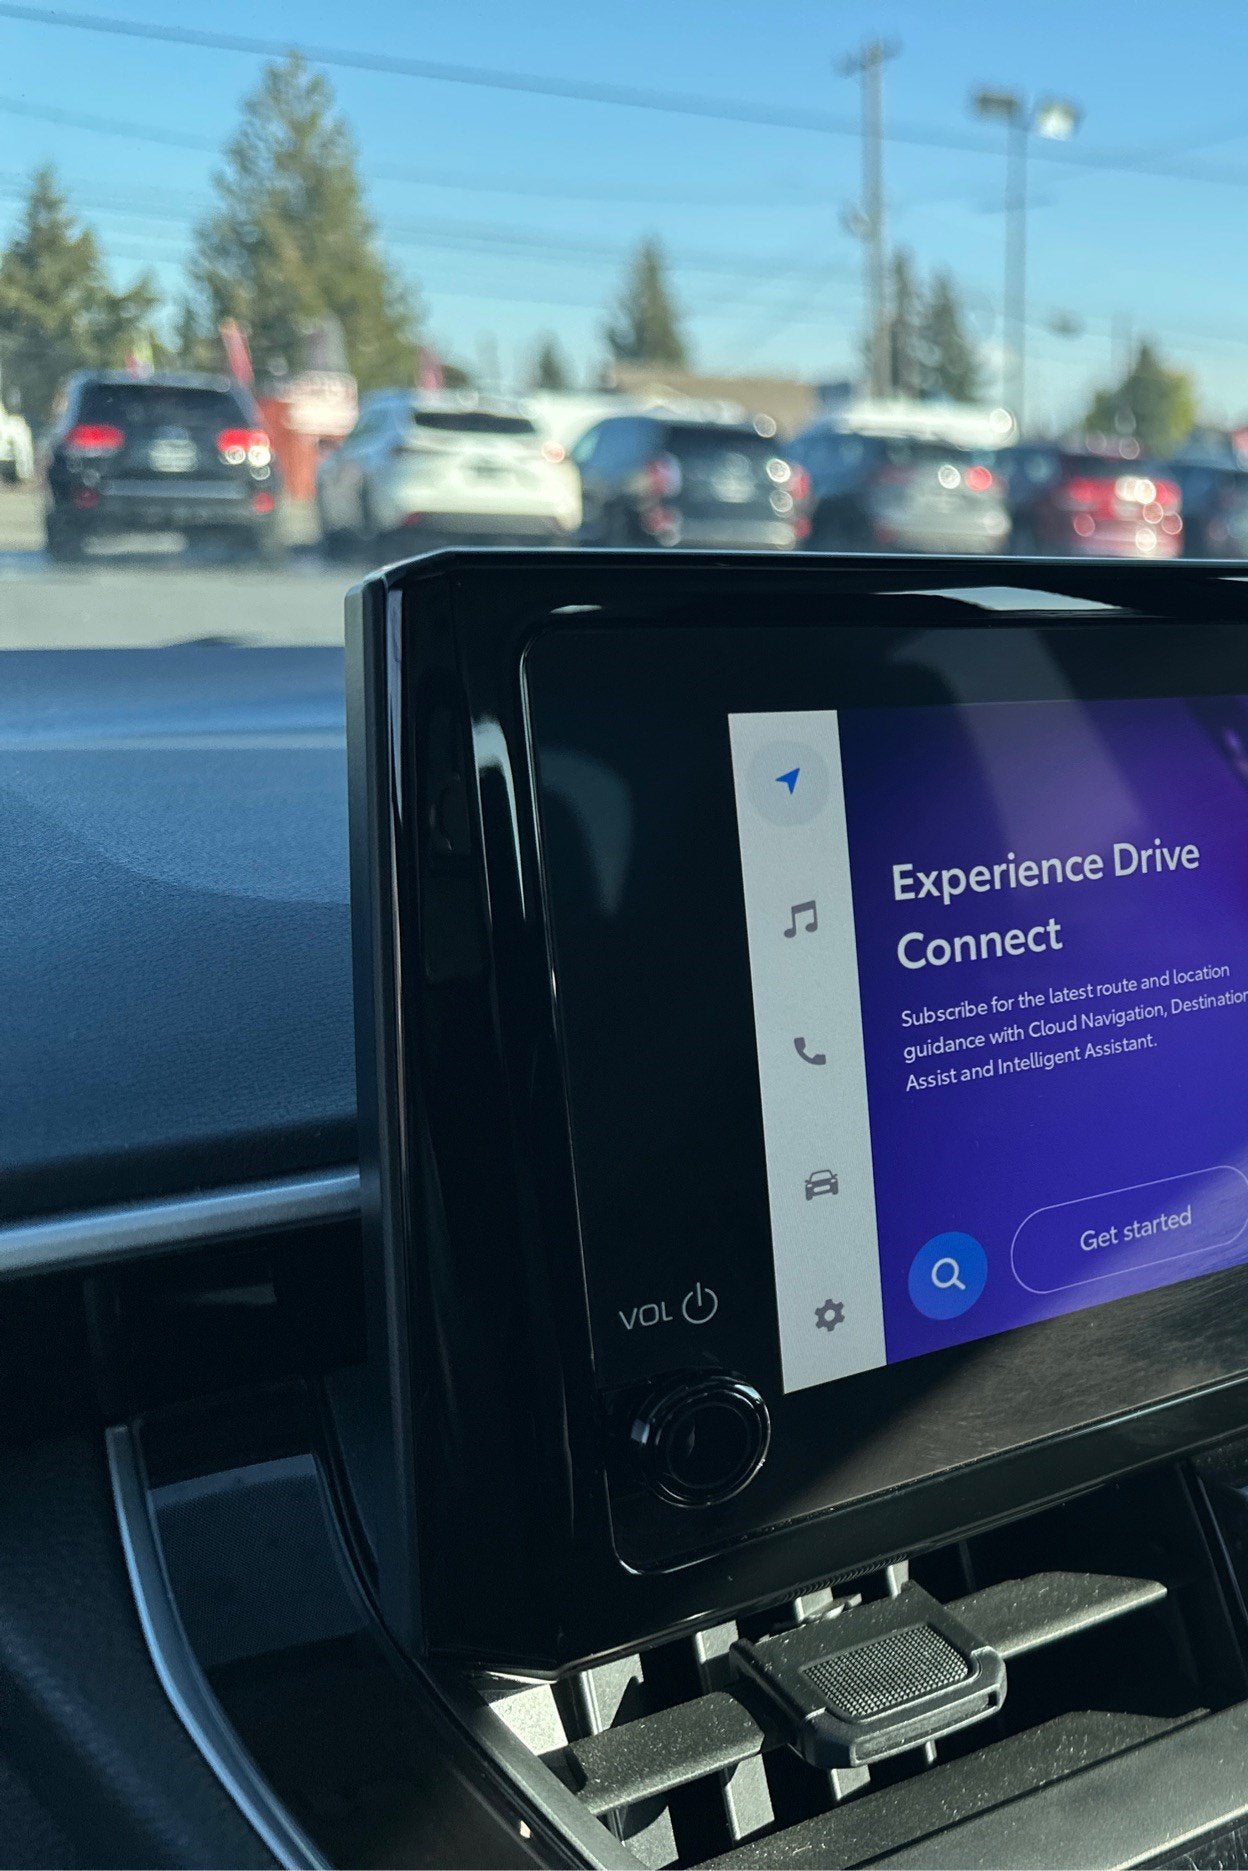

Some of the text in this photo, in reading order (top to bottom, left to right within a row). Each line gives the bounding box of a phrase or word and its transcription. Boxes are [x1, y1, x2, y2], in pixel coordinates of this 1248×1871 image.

[892, 838, 1200, 905] Experience Drive
[897, 918, 1063, 970] Connect
[901, 965, 1230, 1027] Subscribe for the latest route and location
[903, 1033, 985, 1064] guidance
[989, 1024, 1025, 1045] with
[1028, 1015, 1078, 1038] Cloud
[1081, 1003, 1168, 1030] Navigation,
[906, 1033, 1158, 1092] Assist and Intelligent Assistant.
[1080, 1204, 1192, 1251] Get started
[619, 1301, 673, 1330] VOL
